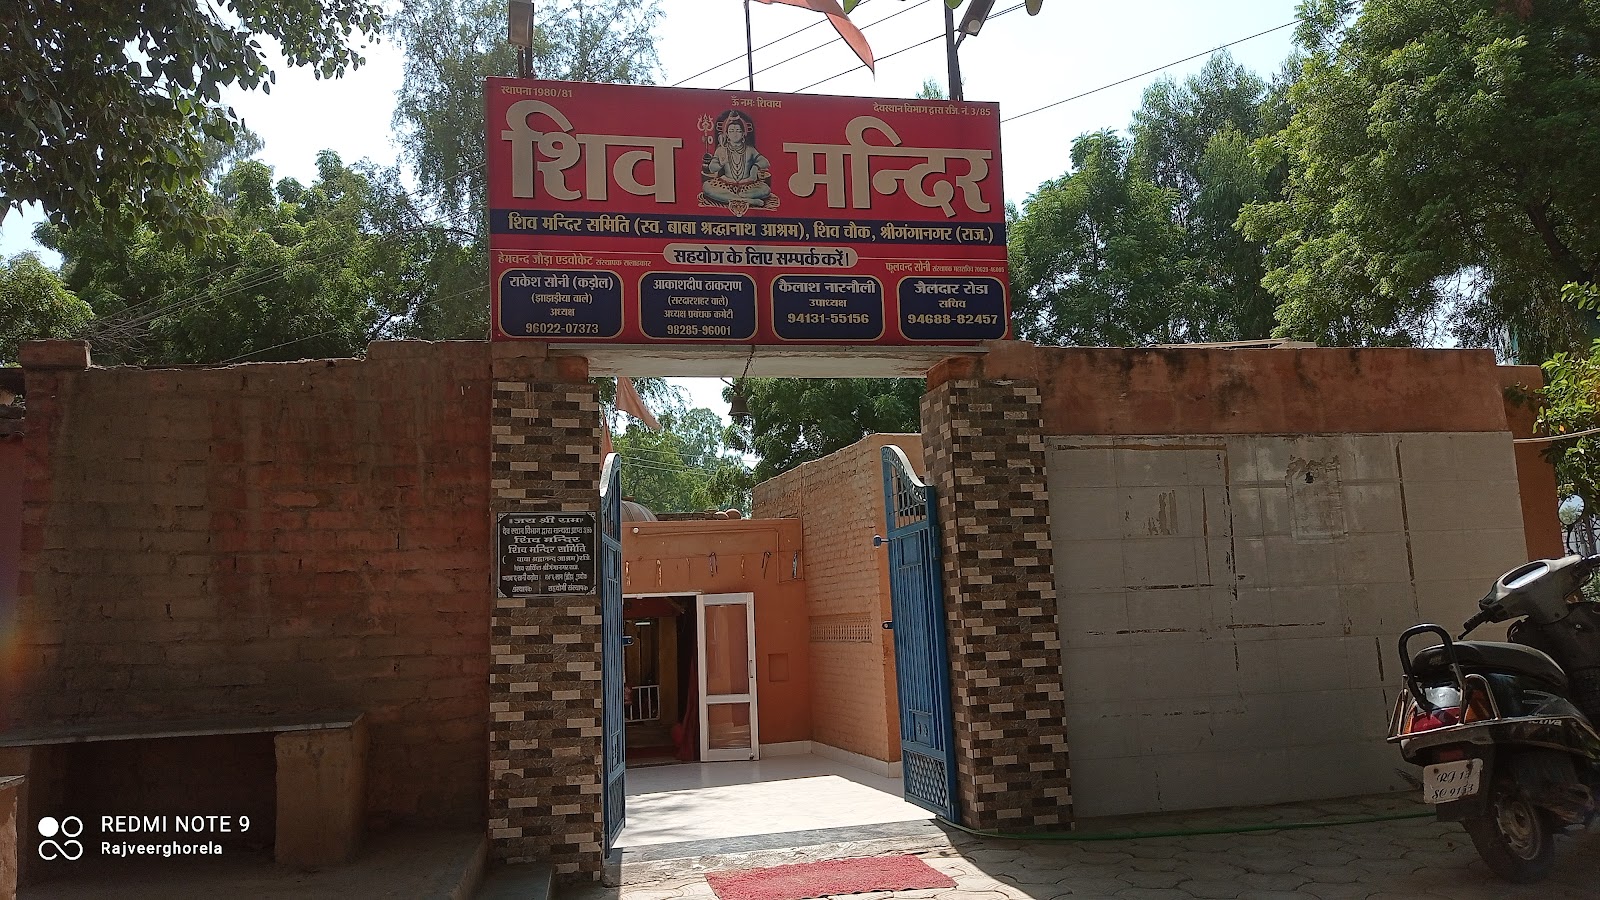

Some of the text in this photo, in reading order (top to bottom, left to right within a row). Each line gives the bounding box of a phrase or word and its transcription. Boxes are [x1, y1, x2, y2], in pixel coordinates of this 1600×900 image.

[501, 85, 572, 98] स्थापना 1980/81
[756, 96, 782, 108] शिवाय
[873, 102, 903, 113] देवस्थान
[904, 102, 927, 113] विभाग
[929, 106, 944, 116] द्वारा
[945, 105, 959, 115] रजि.
[971, 107, 991, 116] 3/85
[501, 99, 683, 203] शिव
[782, 115, 992, 218] मन्दिर
[508, 212, 994, 244] शिव मन्दिर समिति (स्व. बाबा श्रद्धानाथ आश्रम), शिव चौक, श्रीगंगानगर (राज.)
[498, 253, 529, 265] हेमचन्द
[555, 253, 594, 266] एडवोकेट
[674, 245, 724, 264] सहयोग
[726, 246, 742, 264] के
[746, 248, 773, 265] लिए
[914, 260, 931, 272] सोनी
[509, 272, 614, 291] राकेश सोनी (कड़ोल)
[652, 276, 742, 292] आकाशदीप ठाकराण
[778, 278, 877, 295] कैलाश नारनौली
[913, 280, 989, 295] जैलदार रोडा
[573, 292, 593, 305] वाले)
[667, 295, 729, 307] (सरदारशहर वाले)
[808, 298, 847, 308] उपाध्यक्ष
[938, 298, 966, 309] सचिव
[549, 307, 576, 317] अध्यक्ष
[663, 308, 734, 319] अध्यक्ष प्रबंधक कमेटी
[787, 313, 870, 325] 94131-55156
[907, 313, 998, 326] 94688-82457
[525, 322, 599, 334] 96022-07373
[666, 324, 731, 336] 98285-96001
[539, 515, 555, 524] श्री
[513, 535, 581, 544] शिव मन्दिर
[508, 543, 587, 554] शिव मन्दिर समिति
